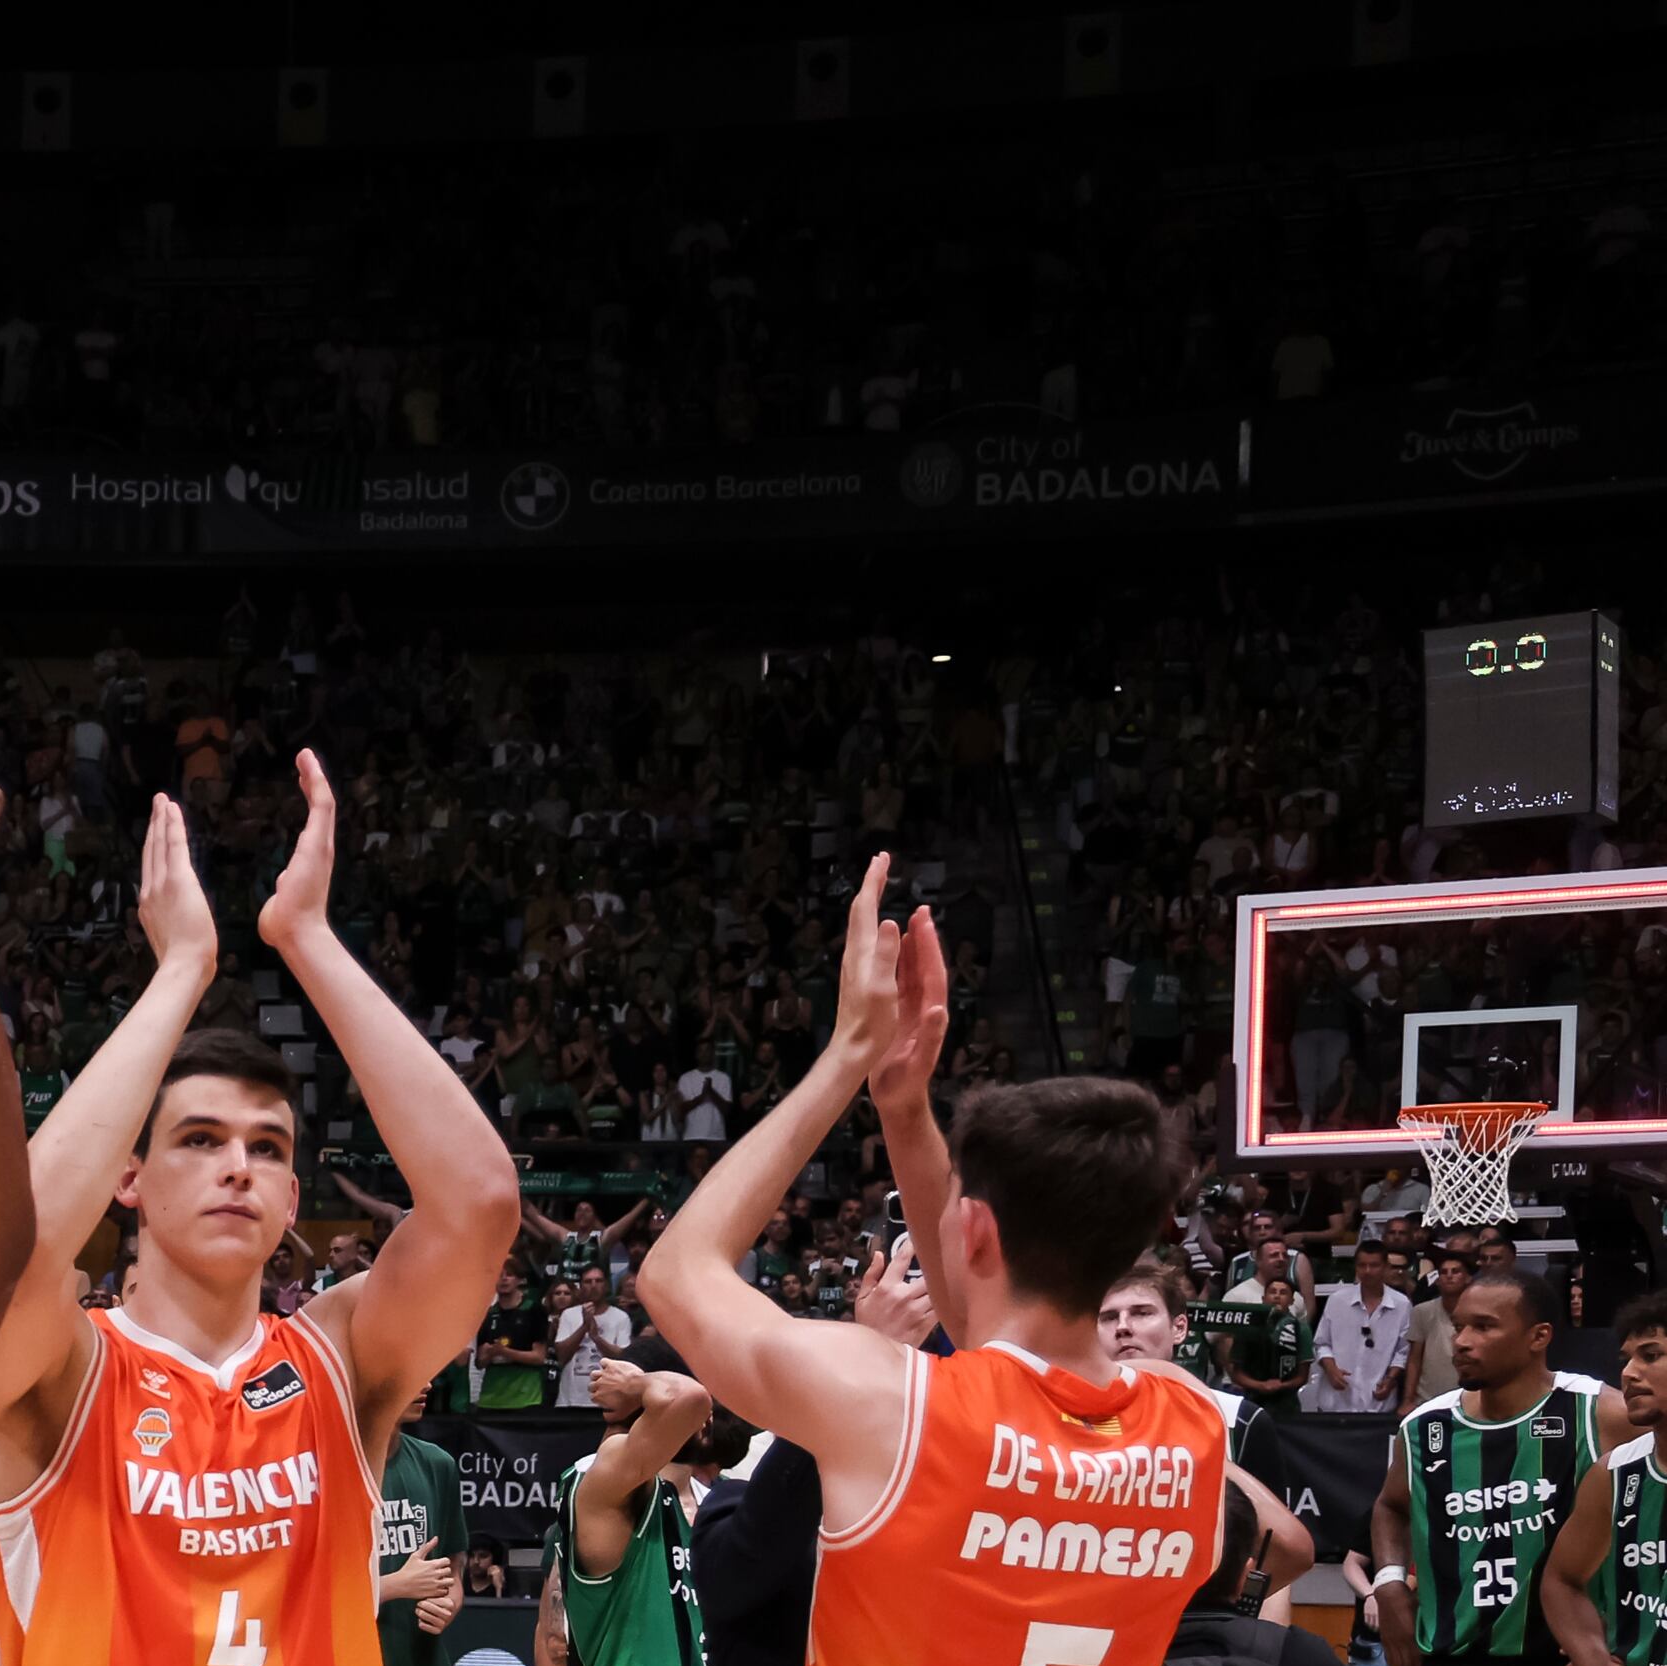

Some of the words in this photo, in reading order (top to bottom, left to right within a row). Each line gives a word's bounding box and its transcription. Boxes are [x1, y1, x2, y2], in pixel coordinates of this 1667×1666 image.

[976, 436, 1041, 467] City
[71, 472, 212, 508] Hospital
[715, 470, 862, 499] Barcelona
[976, 460, 1222, 506] BADALONA
[359, 511, 468, 532] Badalona
[459, 1452, 506, 1479] City
[514, 1453, 539, 1475] of
[986, 1424, 1040, 1495] DE
[1054, 1436, 1195, 1509] LARREA
[125, 1450, 320, 1520] VALENCIA
[1444, 1479, 1529, 1517] asisa
[178, 1518, 292, 1557] BASKET
[959, 1511, 1194, 1578] PAMESA
[1472, 1557, 1519, 1607] 25
